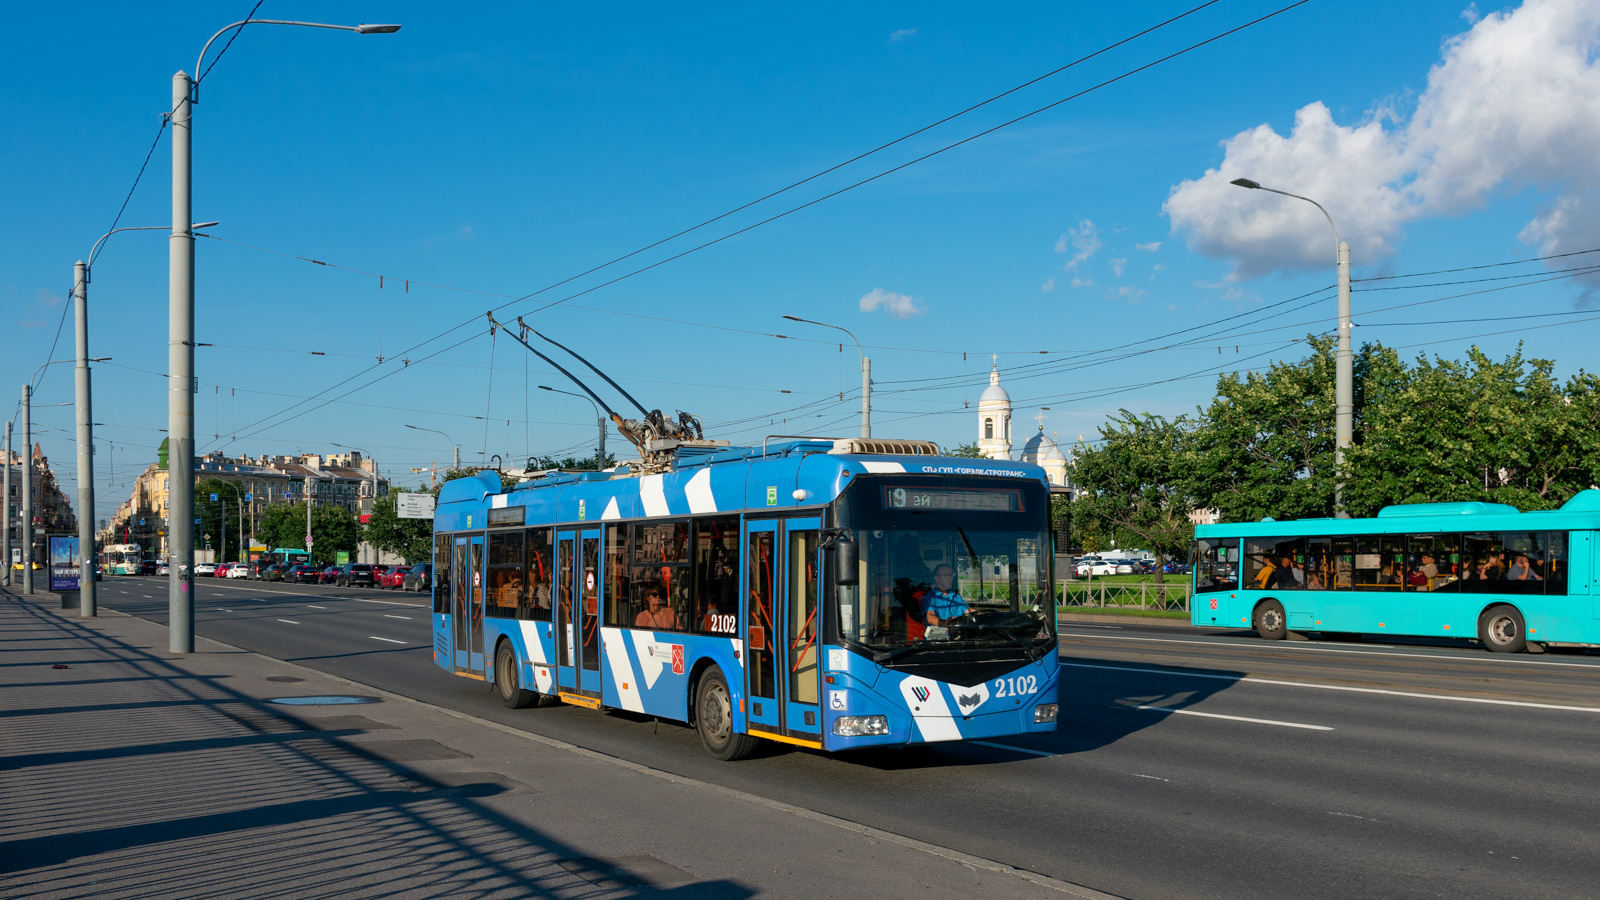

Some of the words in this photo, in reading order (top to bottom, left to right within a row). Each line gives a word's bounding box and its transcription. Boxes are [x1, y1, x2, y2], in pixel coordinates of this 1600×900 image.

[893, 488, 906, 507] 9
[711, 614, 736, 633] 2102
[995, 675, 1038, 698] 2102
